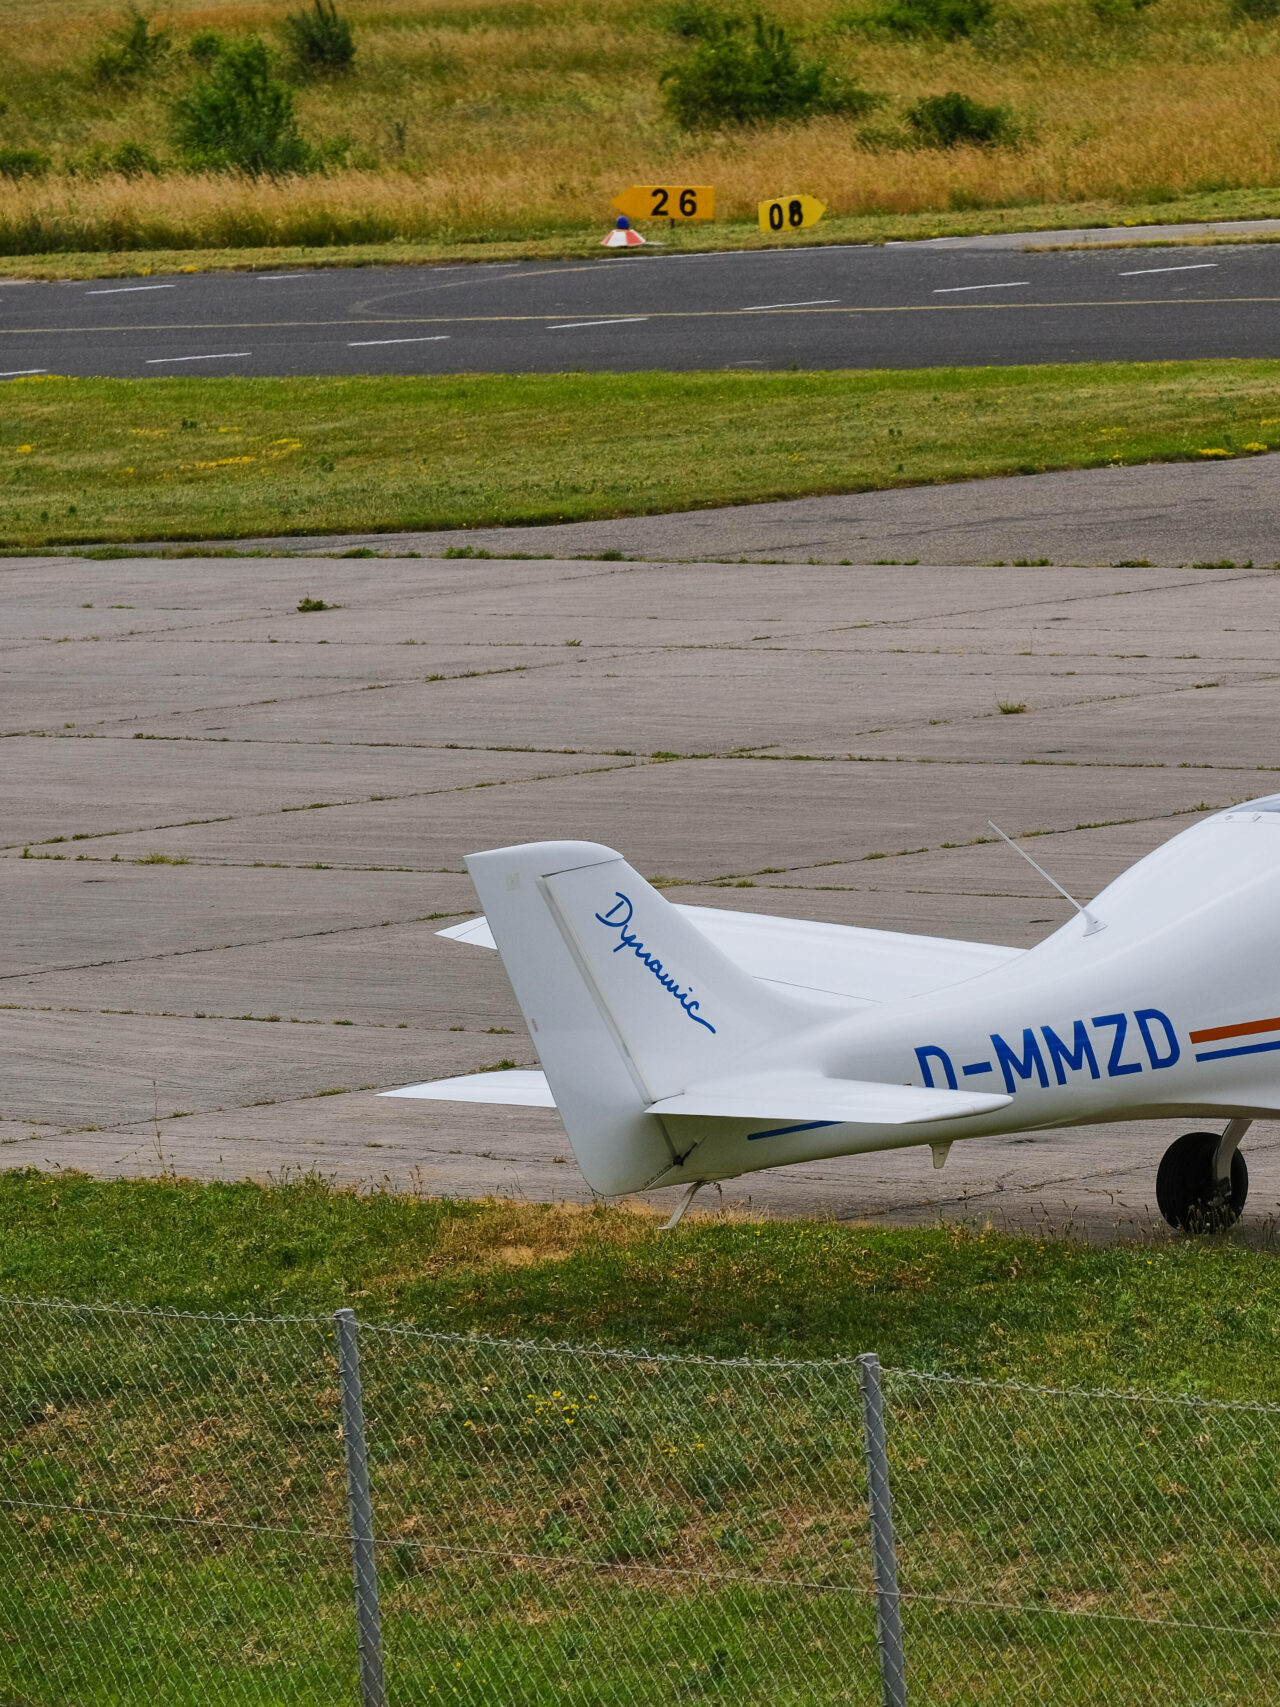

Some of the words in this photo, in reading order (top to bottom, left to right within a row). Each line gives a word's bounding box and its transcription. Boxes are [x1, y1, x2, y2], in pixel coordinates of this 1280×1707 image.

[651, 188, 697, 217] 26
[769, 199, 804, 231] 08
[595, 891, 716, 1034] Dynamic
[914, 1008, 1181, 1094] D-MMZD
